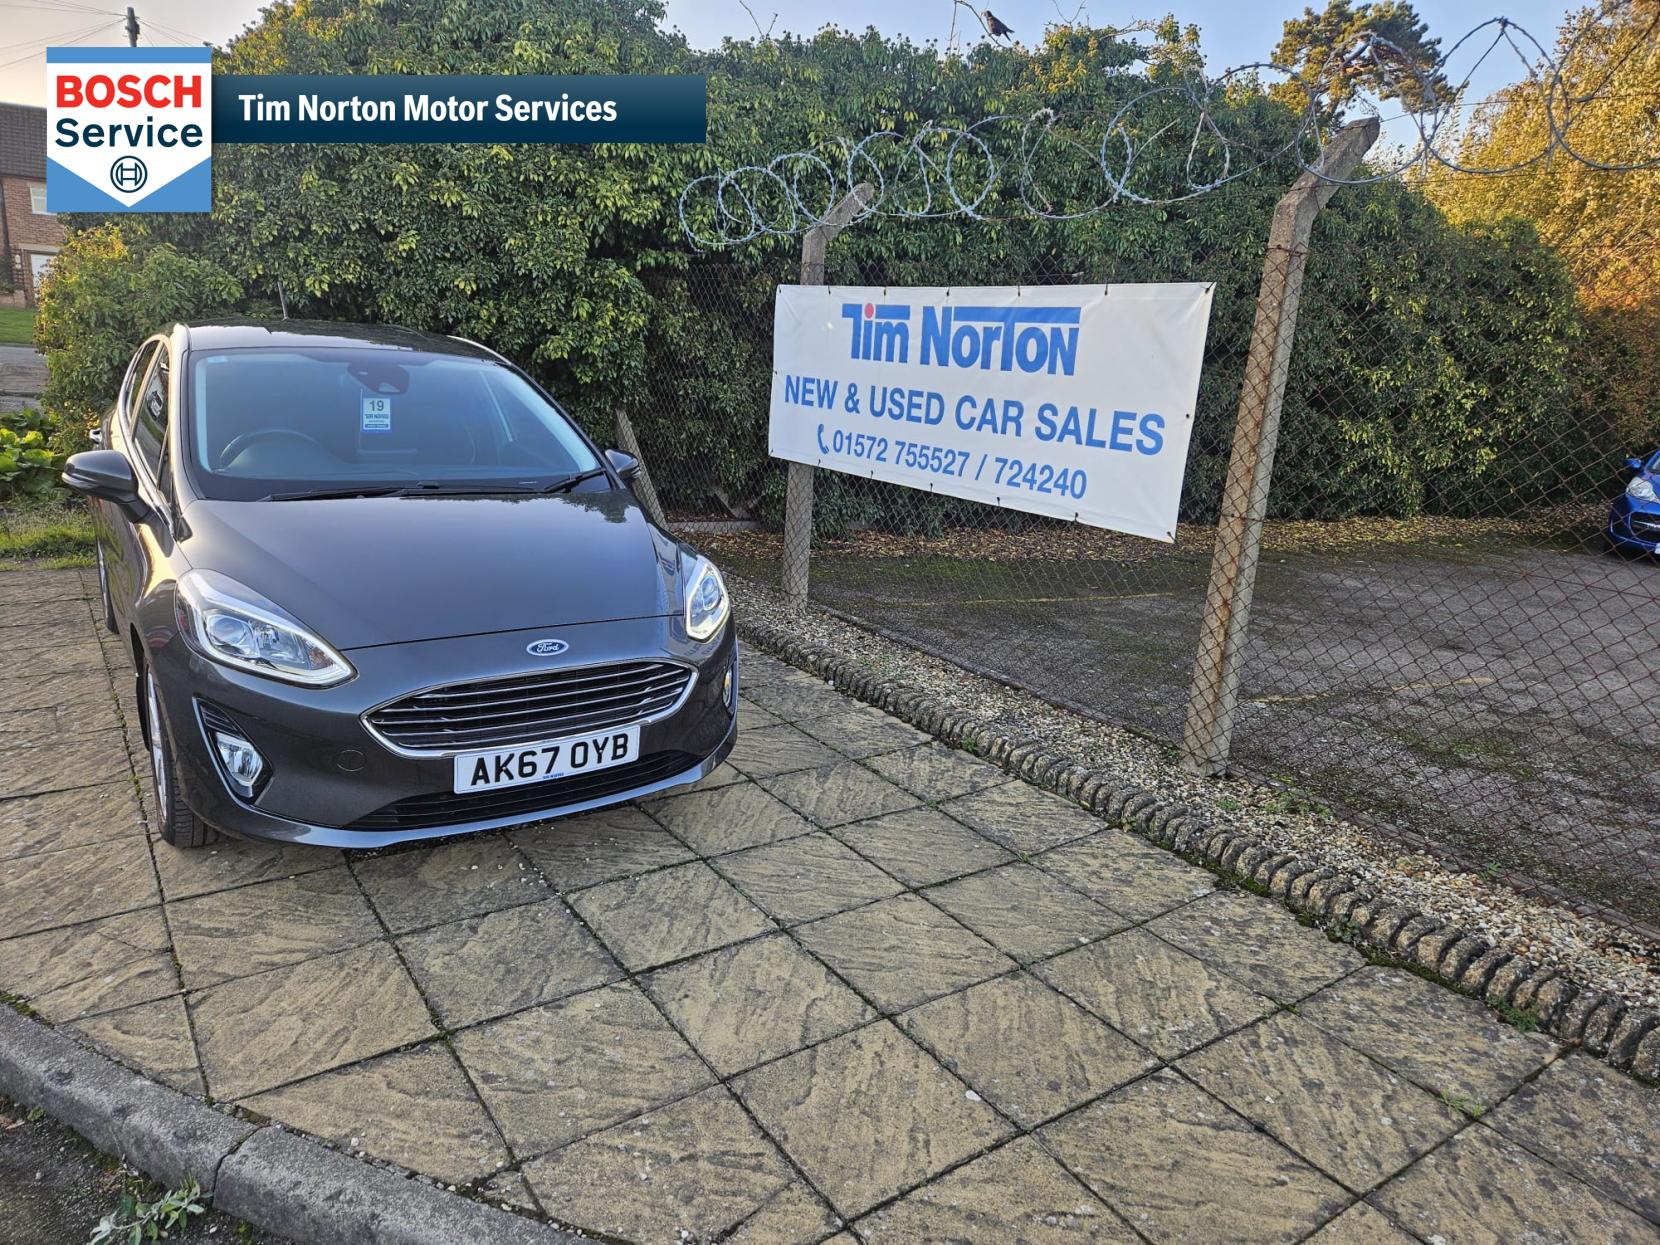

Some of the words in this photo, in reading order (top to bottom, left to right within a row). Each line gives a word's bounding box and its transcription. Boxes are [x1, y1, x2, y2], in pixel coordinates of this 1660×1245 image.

[842, 303, 910, 364] Tim
[369, 400, 384, 411] 19
[784, 374, 839, 409] NEW
[843, 382, 861, 414] &
[869, 386, 945, 426] USED
[955, 395, 1024, 437] CAR
[1035, 403, 1165, 456] SALES
[832, 429, 888, 462] 01572
[894, 440, 970, 478] 755527
[975, 454, 987, 481] /
[994, 457, 1087, 500] 724240
[536, 642, 560, 652] Ford
[470, 746, 560, 786] AK67
[570, 733, 629, 769] OYB
